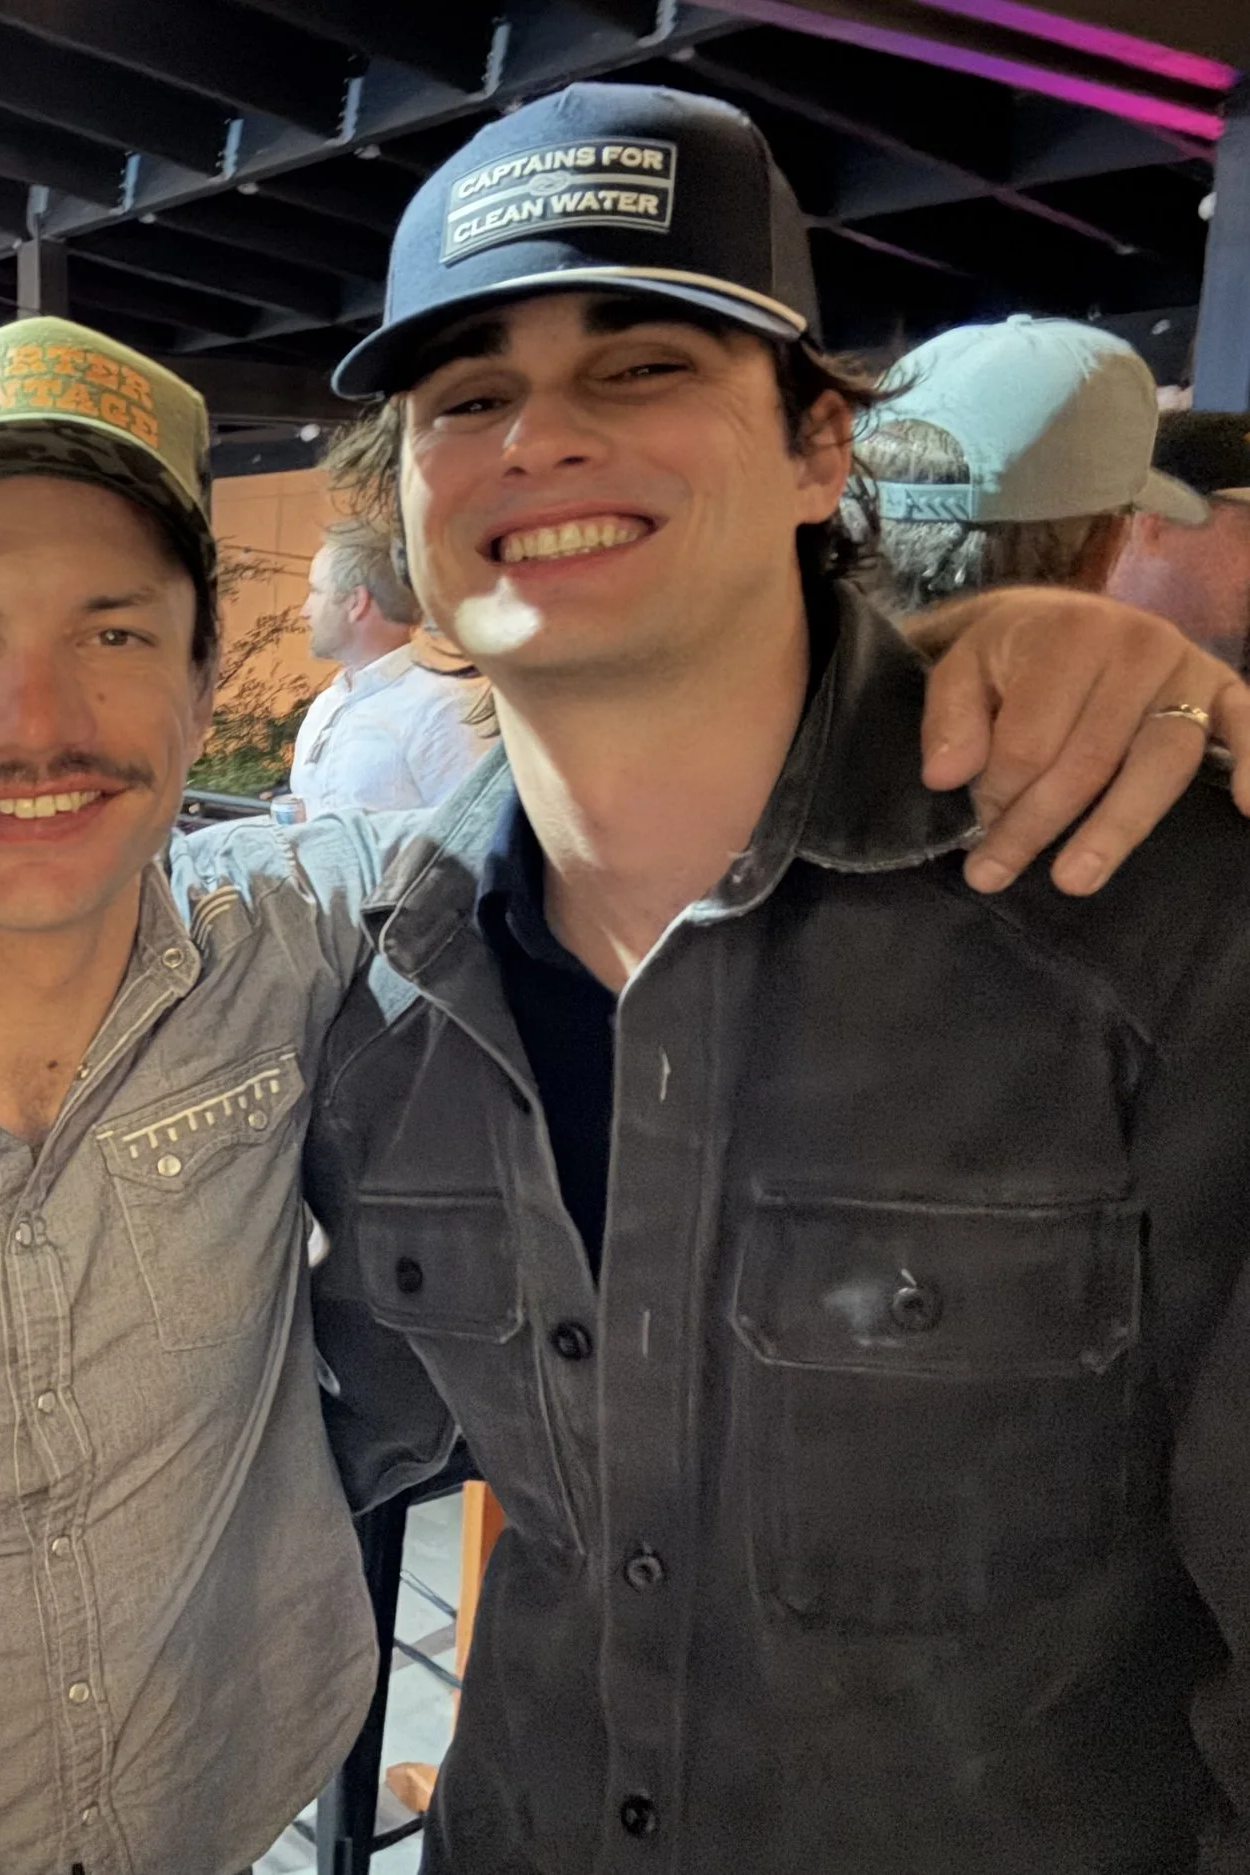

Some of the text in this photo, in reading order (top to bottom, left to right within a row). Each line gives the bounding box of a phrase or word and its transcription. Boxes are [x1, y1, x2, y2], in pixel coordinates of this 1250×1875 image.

[458, 146, 664, 197] CAPTAINS FOR
[454, 191, 658, 243] CLEAN WATER
